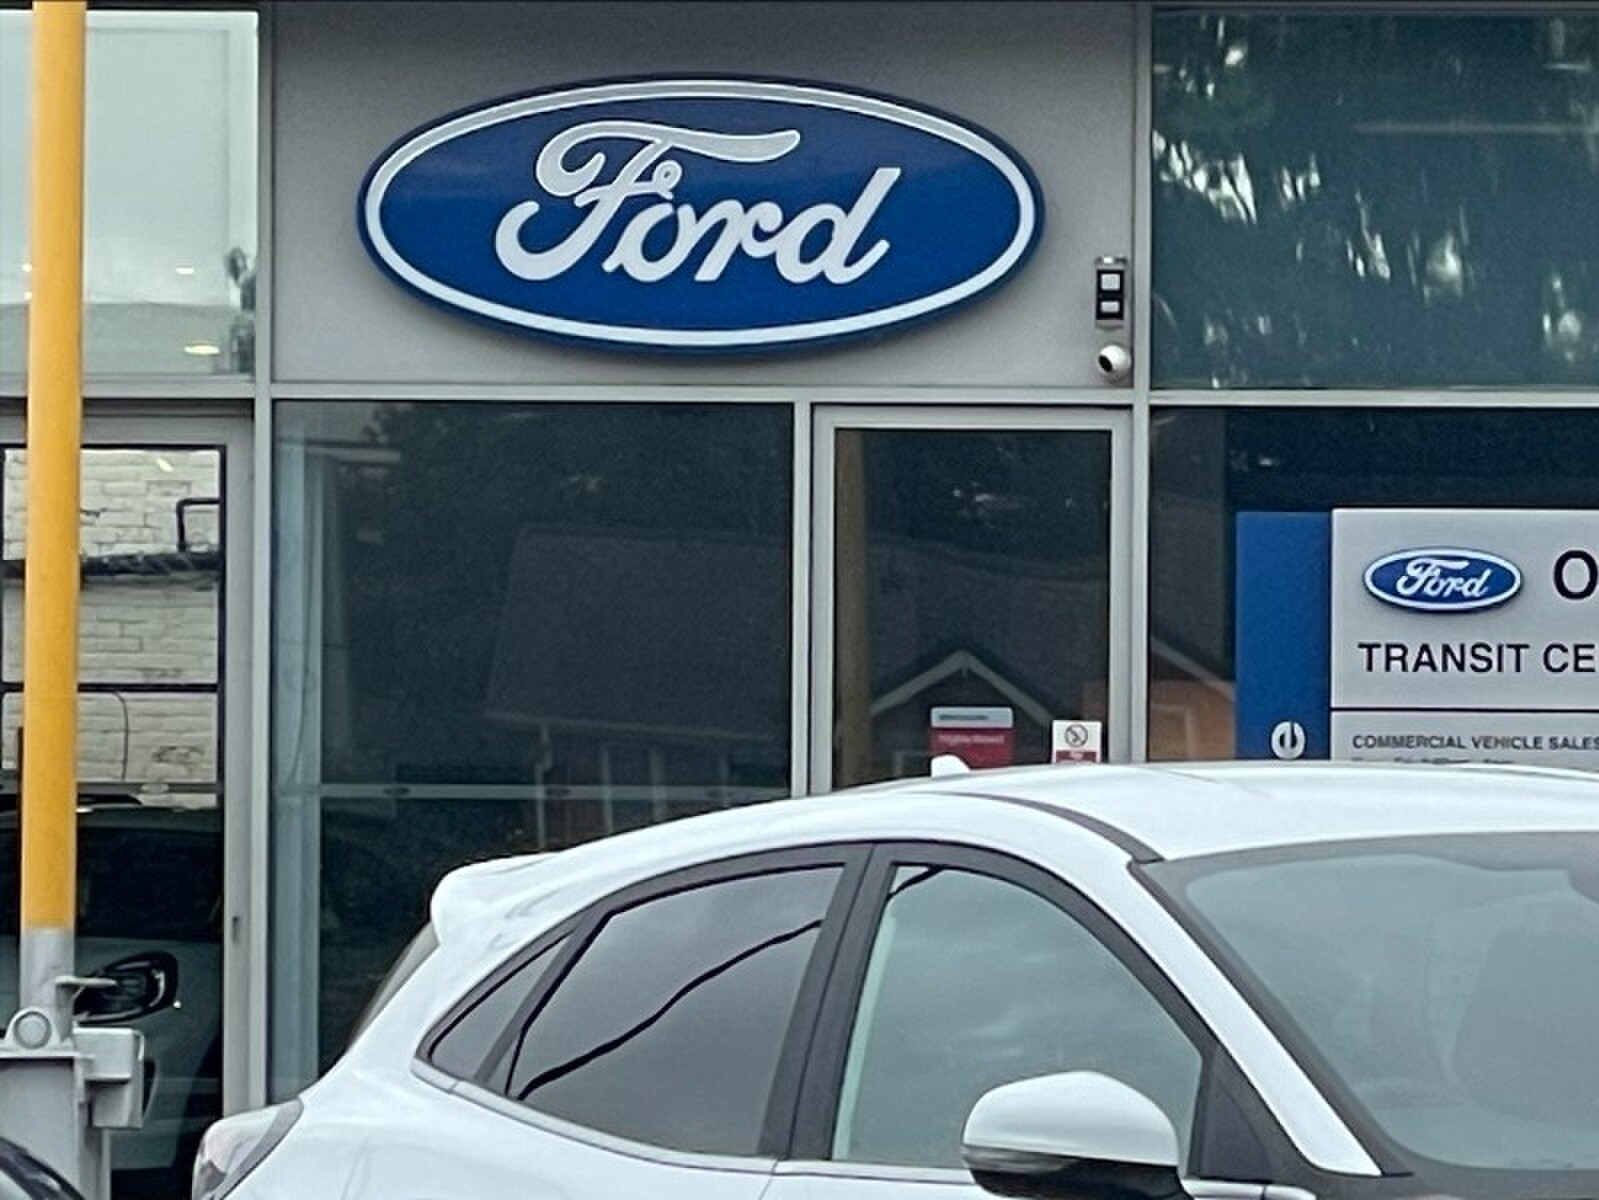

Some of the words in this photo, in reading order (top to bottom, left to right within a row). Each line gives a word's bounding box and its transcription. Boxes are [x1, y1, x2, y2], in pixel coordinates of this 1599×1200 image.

[495, 119, 902, 283] Ford
[1396, 555, 1489, 600] Ford
[1357, 641, 1529, 674] TRANSIT
[1351, 734, 1466, 750] COMMERCIAL
[1470, 735, 1544, 750] VEHICLE
